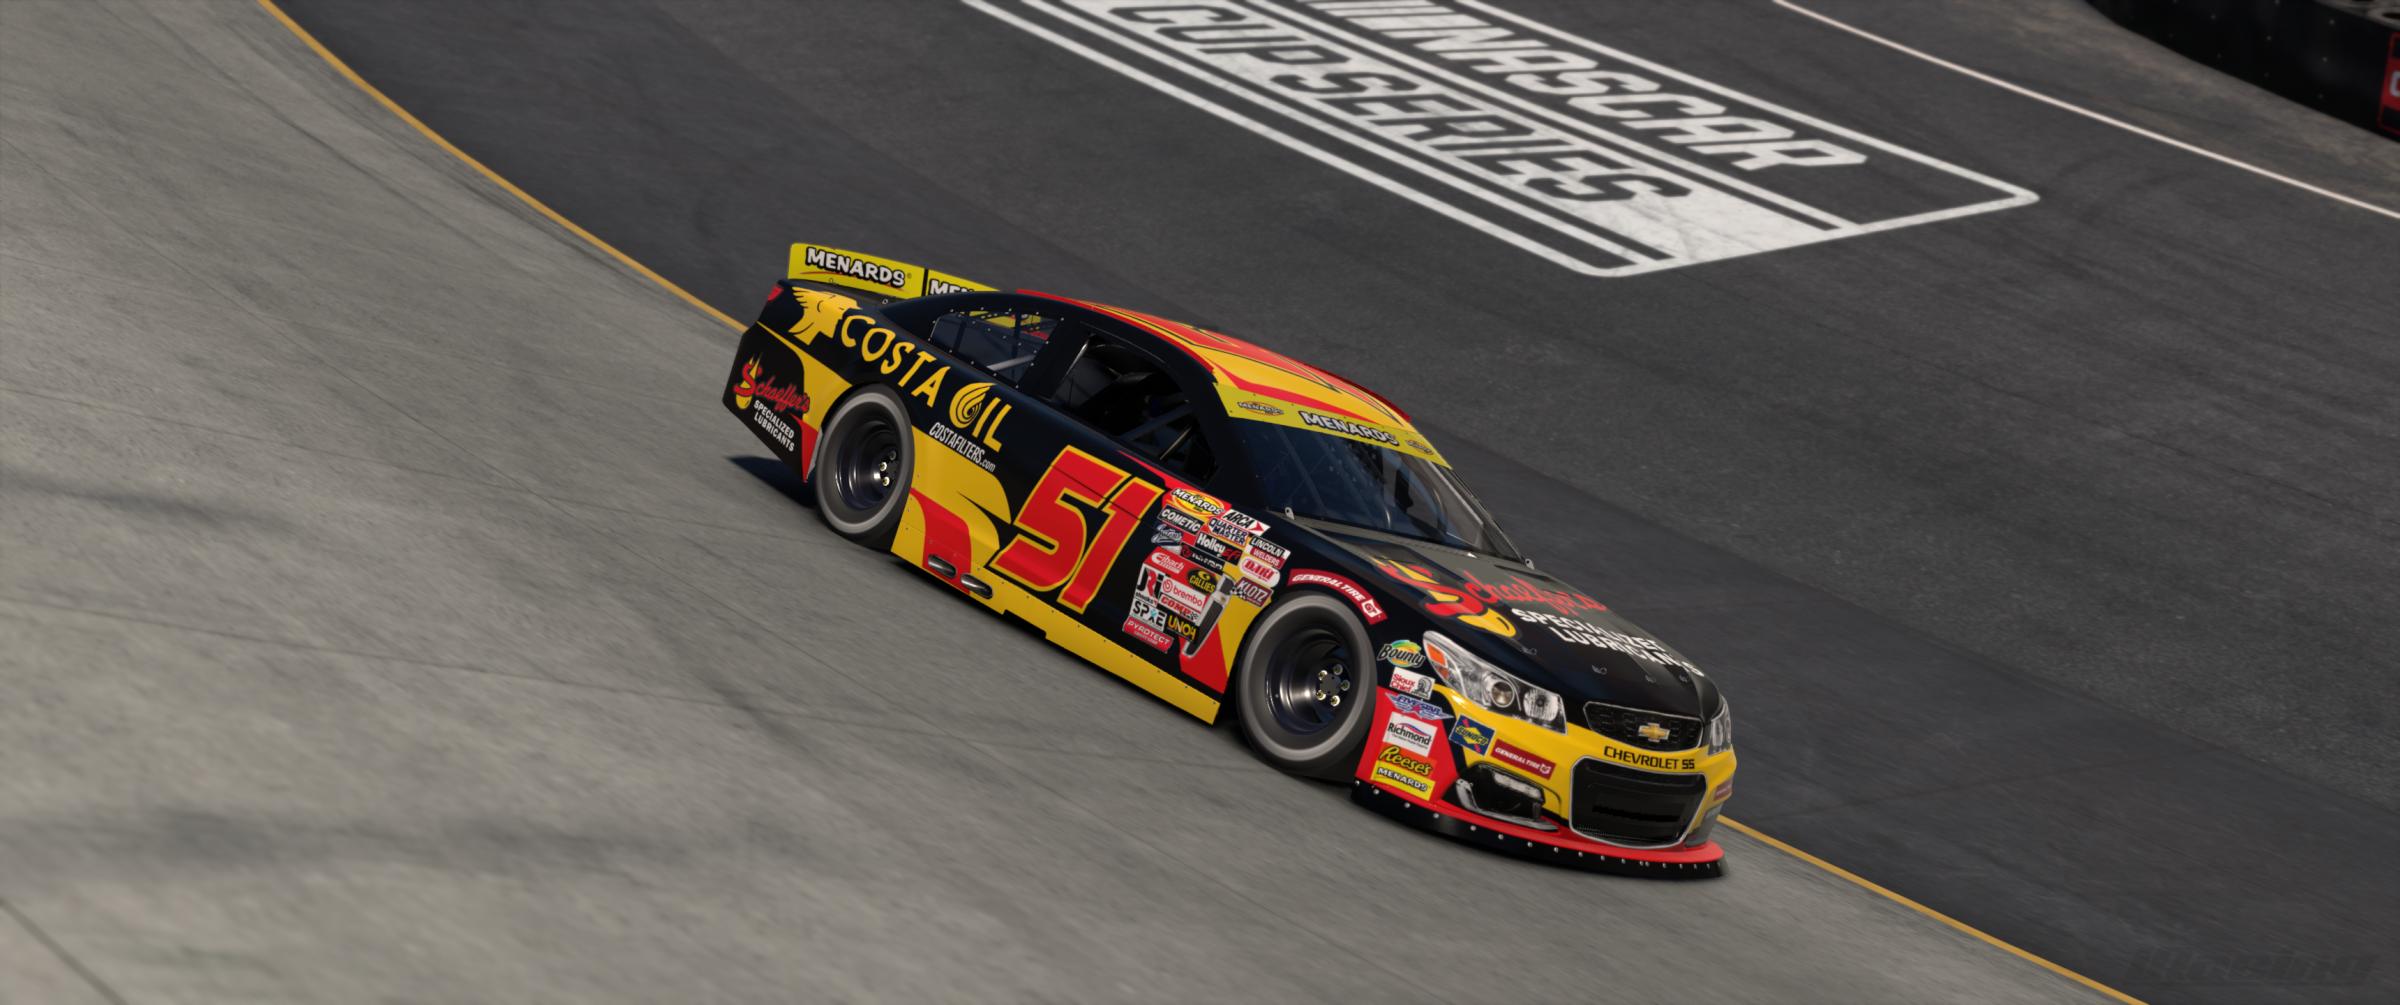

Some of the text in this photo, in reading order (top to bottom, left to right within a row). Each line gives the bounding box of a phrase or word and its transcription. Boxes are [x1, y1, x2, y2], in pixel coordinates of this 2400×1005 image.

[1108, 5, 1693, 202] CUP SERIES
[1378, 26, 1867, 171] NASCAR
[806, 246, 905, 287] MENARDS
[841, 315, 1012, 453] COSTA OIL
[753, 399, 795, 439] SPECIALIZED
[1299, 411, 1400, 446] MENARDS
[753, 412, 795, 452] LUBRICANTS
[929, 421, 996, 472] COSTAFILTERS.com
[1171, 488, 1224, 516] MENARDS
[989, 444, 1165, 615] 51
[1161, 509, 1201, 532] COMETIC
[1222, 511, 1254, 529] ARCA
[1196, 531, 1226, 558] Holley
[1212, 525, 1246, 546] MASTER
[1251, 537, 1284, 557] LINCOLN
[1253, 548, 1281, 567] WELDERS
[1189, 574, 1216, 593] CALLIES
[1239, 579, 1269, 603] KLOTZ
[1292, 574, 1343, 588] GENERAL
[1341, 584, 1366, 602] TIRE
[1173, 586, 1203, 607] brembo
[1378, 644, 1425, 667] Bounty
[1392, 673, 1416, 687] Sioux
[1387, 722, 1433, 746] Richmond
[1455, 725, 1489, 746] SUNOCO
[1380, 745, 1433, 776] Reese's
[1494, 747, 1526, 763] GENERAL
[1603, 745, 1695, 770] CHEVROLET SS
[1377, 766, 1429, 792] MENARDS
